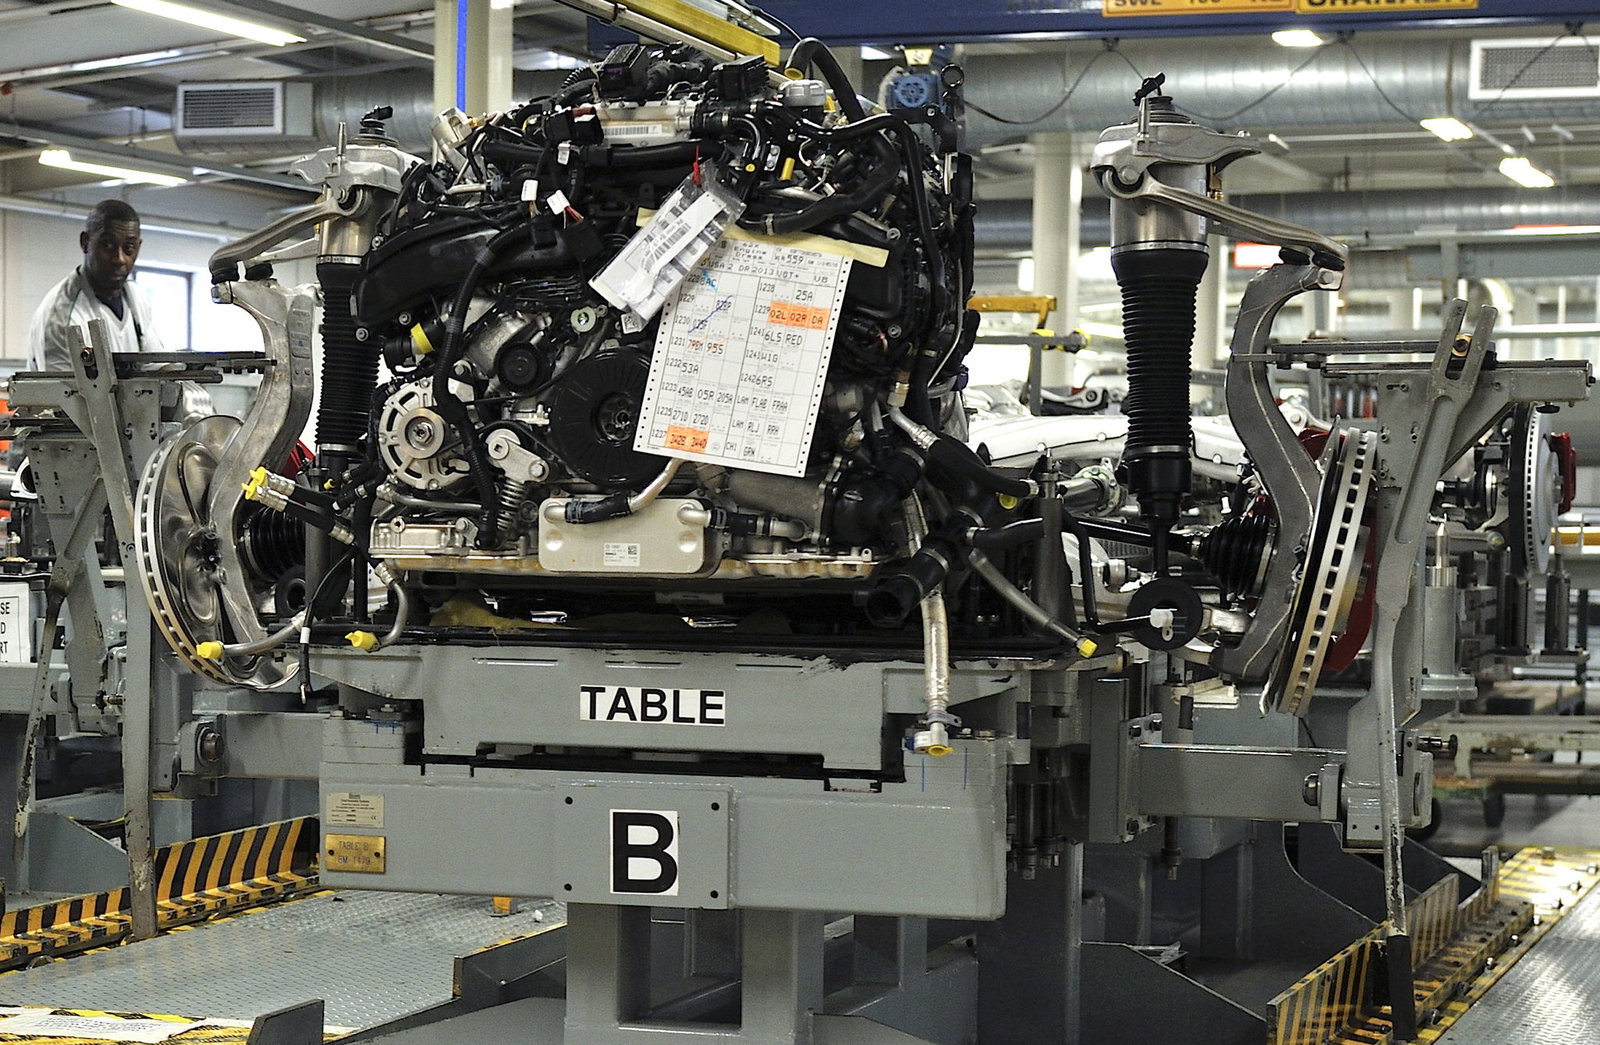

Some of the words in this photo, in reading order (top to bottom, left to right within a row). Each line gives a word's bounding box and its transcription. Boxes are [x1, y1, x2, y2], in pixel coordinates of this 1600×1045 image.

[786, 254, 804, 264] 559
[795, 289, 813, 302] 25A
[785, 333, 803, 346] RED
[681, 362, 699, 374] 53A
[580, 685, 725, 725] TABLE
[338, 840, 360, 851] TABLE
[612, 811, 679, 894] B
